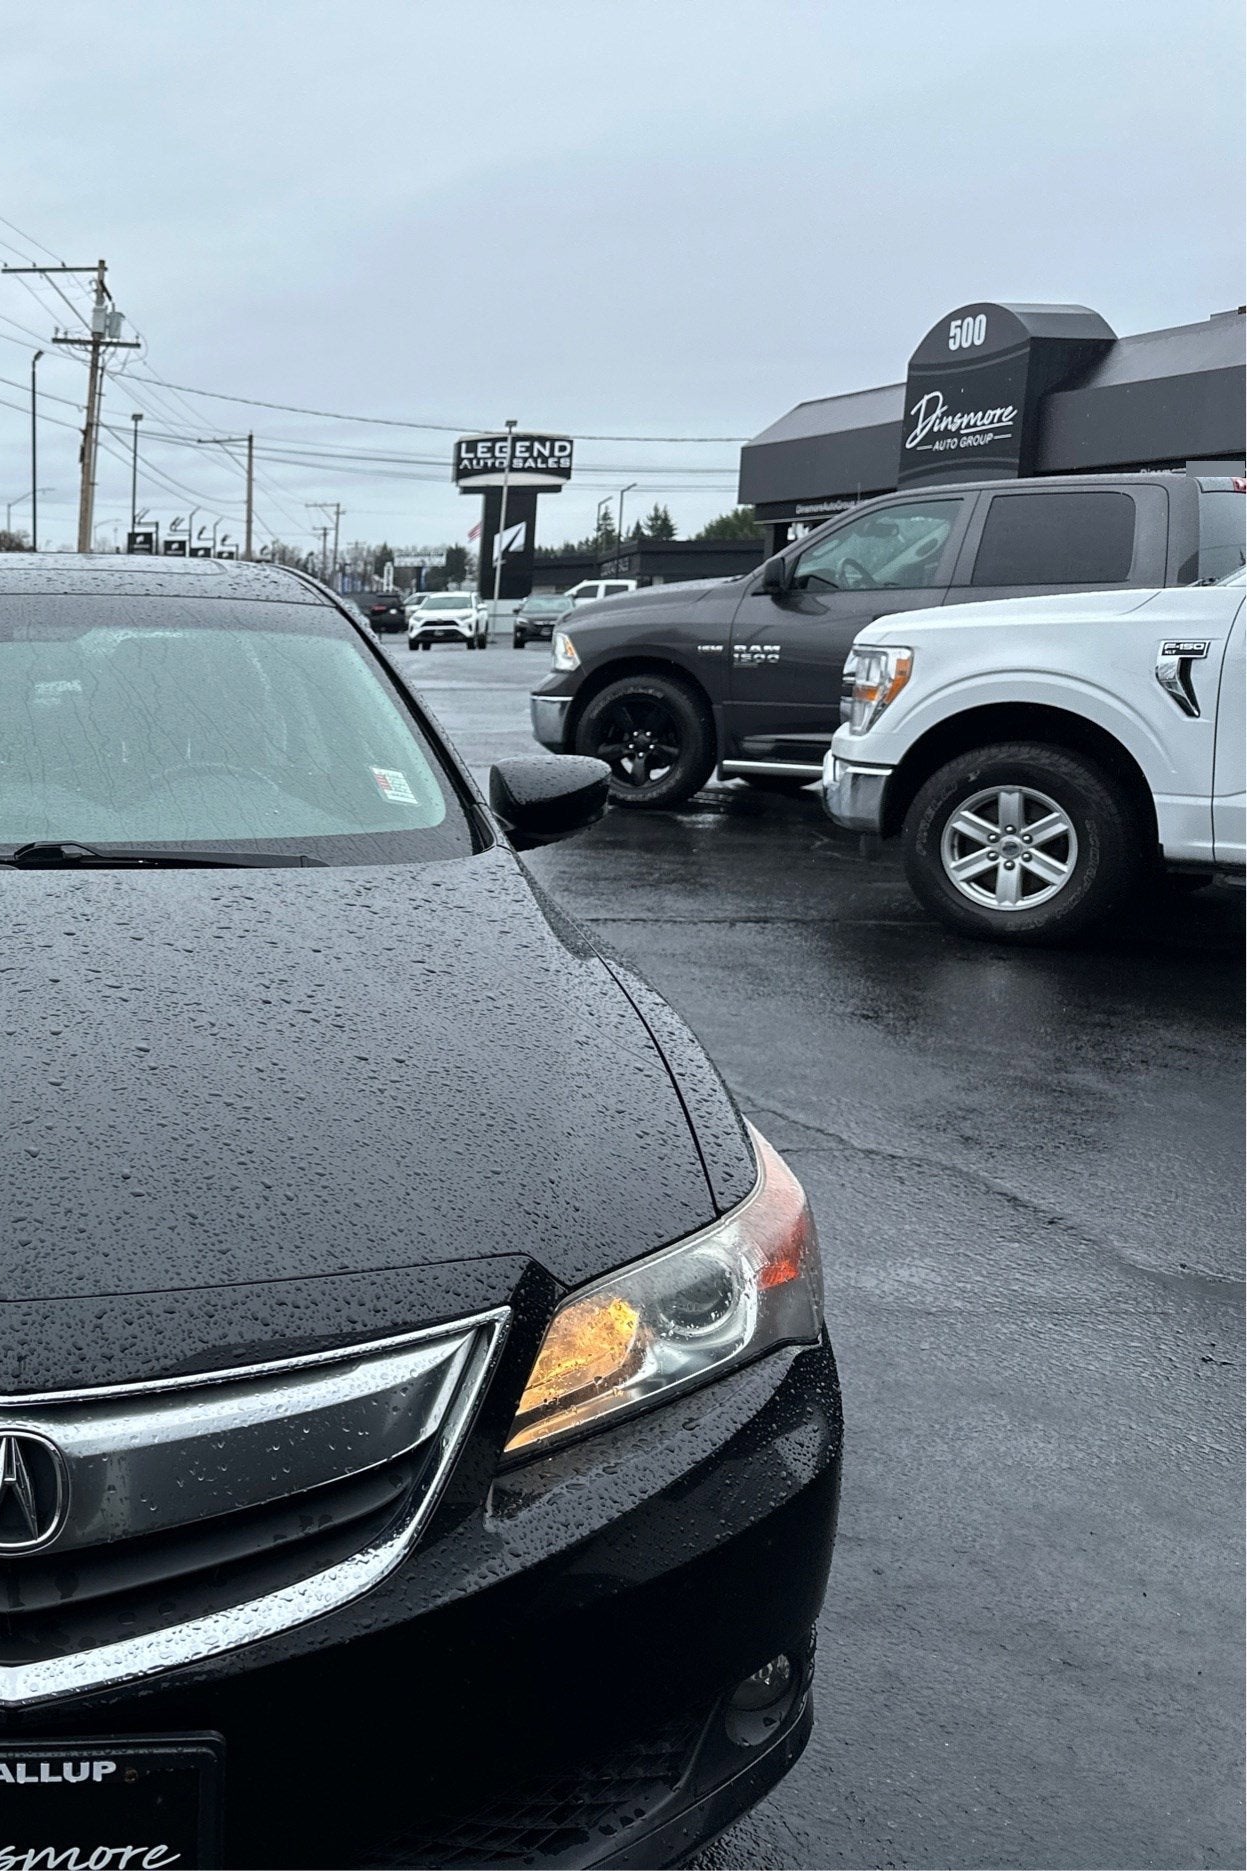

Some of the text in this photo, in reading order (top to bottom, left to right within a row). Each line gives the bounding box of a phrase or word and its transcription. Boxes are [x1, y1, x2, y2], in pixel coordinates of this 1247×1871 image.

[949, 314, 987, 350] 500
[905, 391, 1018, 449] Dinsmore
[460, 441, 572, 458] LEGEND
[933, 433, 994, 451] AUTO GROUP
[459, 458, 571, 470] AUTO SALES
